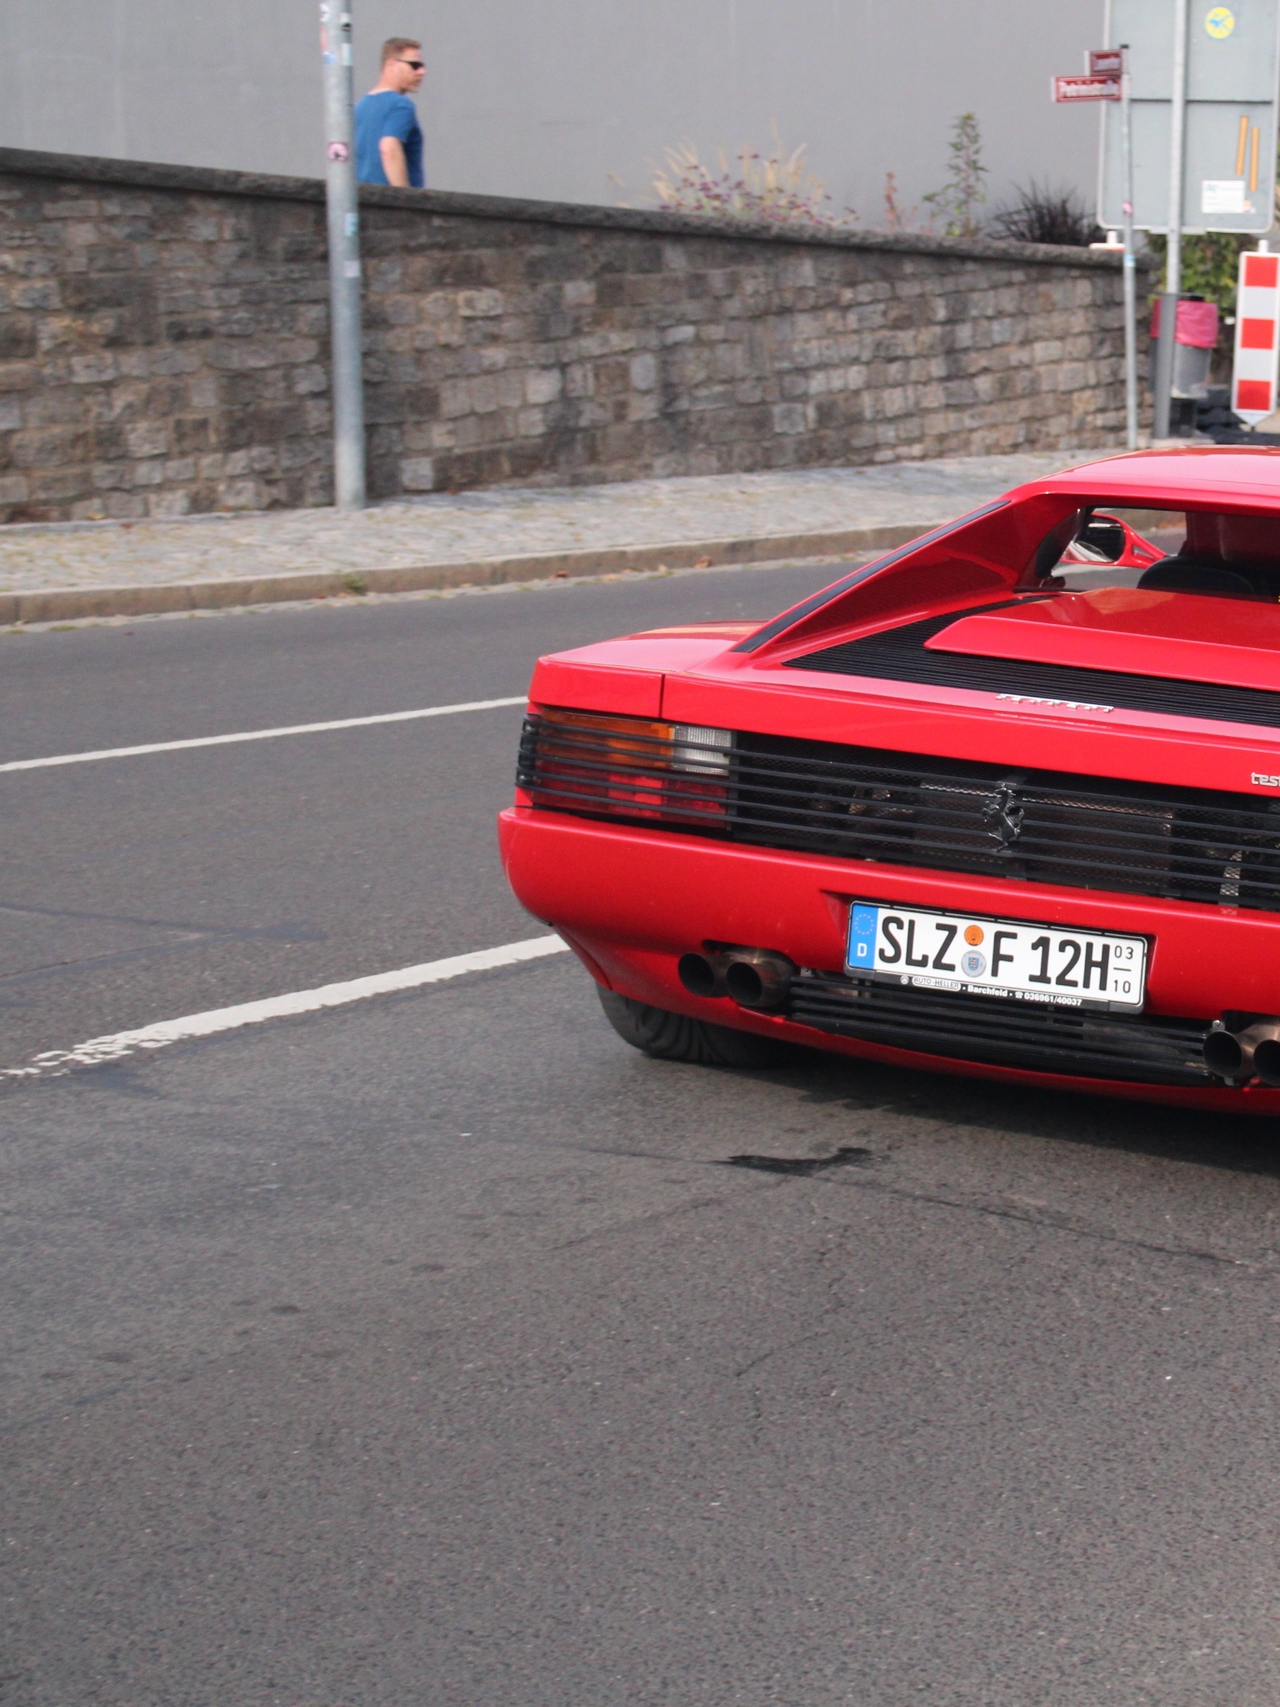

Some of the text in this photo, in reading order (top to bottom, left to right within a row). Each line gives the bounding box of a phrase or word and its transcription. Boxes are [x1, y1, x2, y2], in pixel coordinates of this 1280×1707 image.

[856, 942, 868, 957] D
[877, 915, 1111, 991] SLZ F 12H
[1113, 944, 1134, 960] 03
[967, 985, 1008, 997] Barchfeld
[1112, 979, 1132, 994] 10
